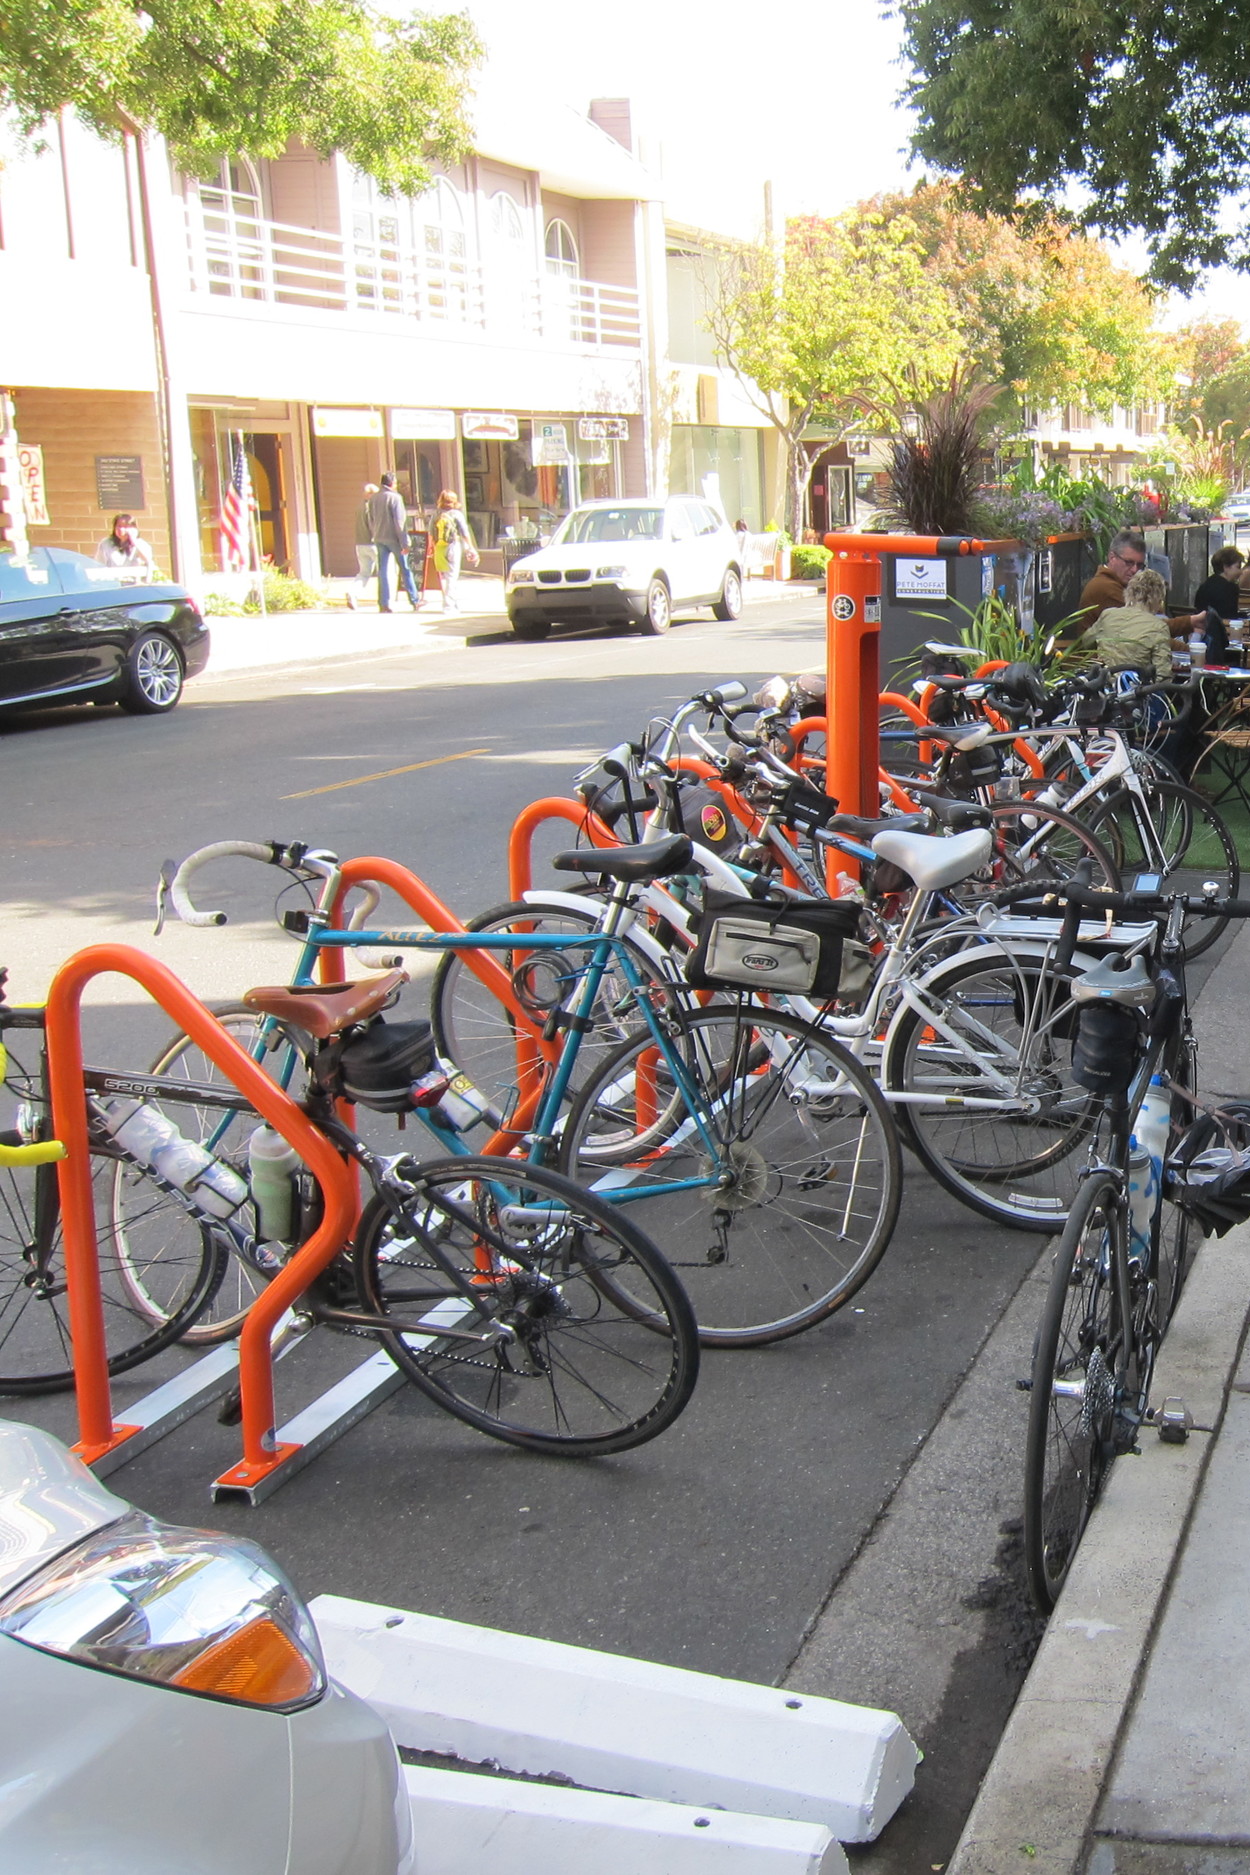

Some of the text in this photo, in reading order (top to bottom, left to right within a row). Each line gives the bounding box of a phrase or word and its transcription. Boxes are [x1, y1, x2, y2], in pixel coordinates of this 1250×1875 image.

[20, 450, 46, 520] OPEN
[796, 863, 830, 900] TRE
[104, 1078, 159, 1097] 5200
